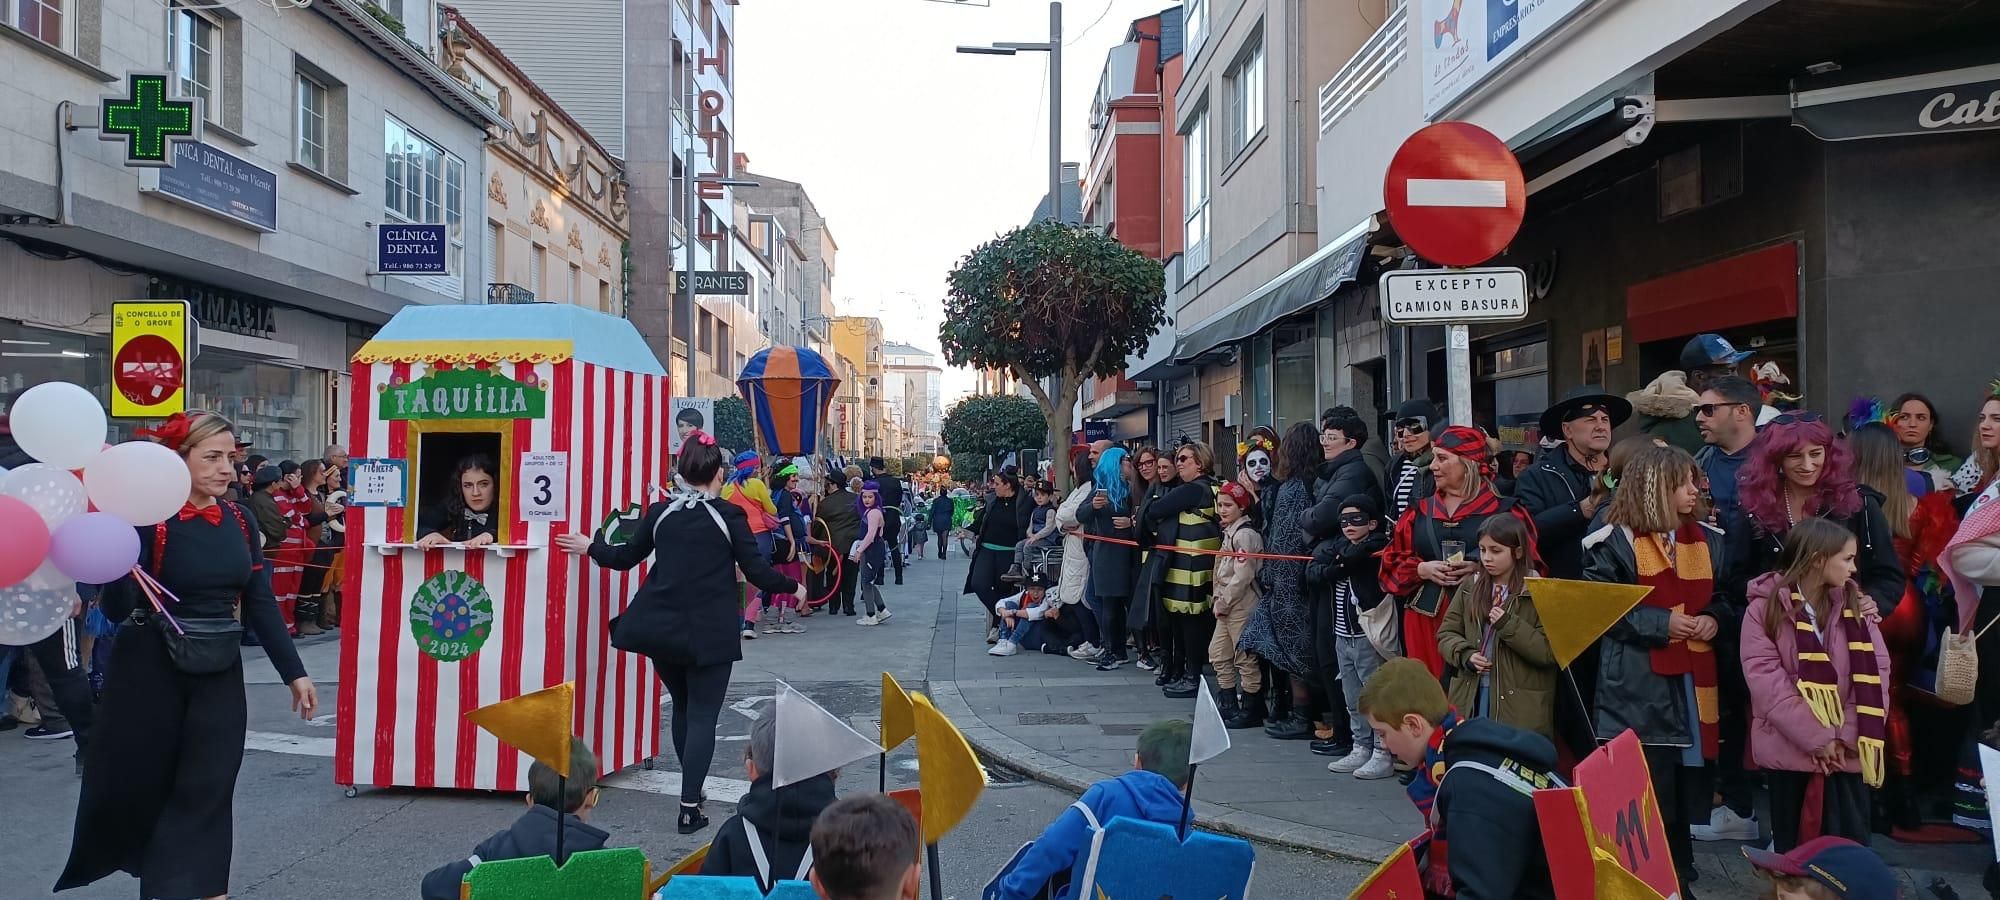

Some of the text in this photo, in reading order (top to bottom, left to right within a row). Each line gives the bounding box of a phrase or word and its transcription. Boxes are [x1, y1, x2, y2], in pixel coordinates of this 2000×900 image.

[1492, 3, 1535, 43] EMPRESARIOS
[698, 48, 724, 240] HOTEL
[175, 143, 271, 192] NICA DENTAL San Vicente
[386, 228, 438, 241] CLÍNICA
[387, 244, 438, 254] DENTAL
[679, 275, 745, 290] SRANTES
[1415, 277, 1497, 291] EXCEPTO
[1395, 299, 1519, 313] CAMION BASURA
[363, 463, 394, 473] TICKETS
[533, 475, 552, 506] 3
[429, 640, 469, 656] 2024
[1615, 799, 1650, 874] 11
